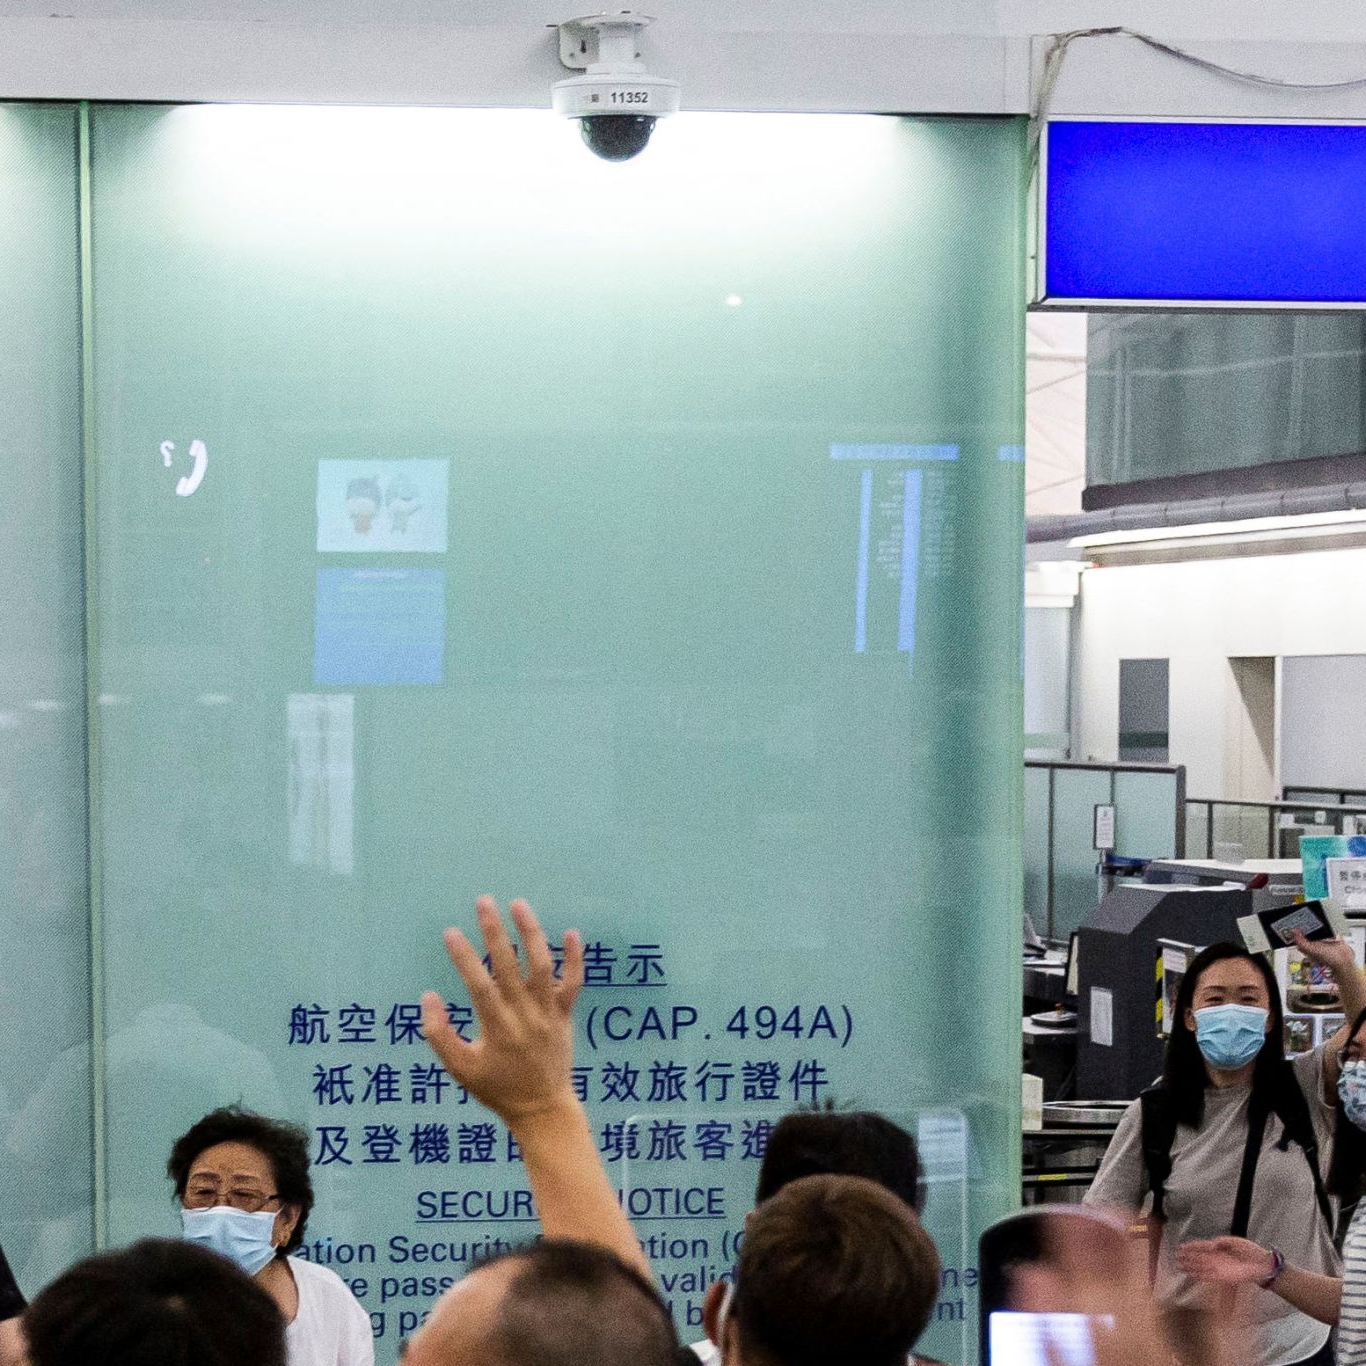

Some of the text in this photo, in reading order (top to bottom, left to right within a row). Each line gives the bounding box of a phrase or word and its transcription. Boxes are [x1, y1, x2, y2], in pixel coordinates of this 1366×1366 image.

[610, 92, 649, 104] 11352
[288, 1003, 853, 1050] 航空保安 (CAP. 494A)
[416, 1188, 725, 1218] SECUR OTICE
